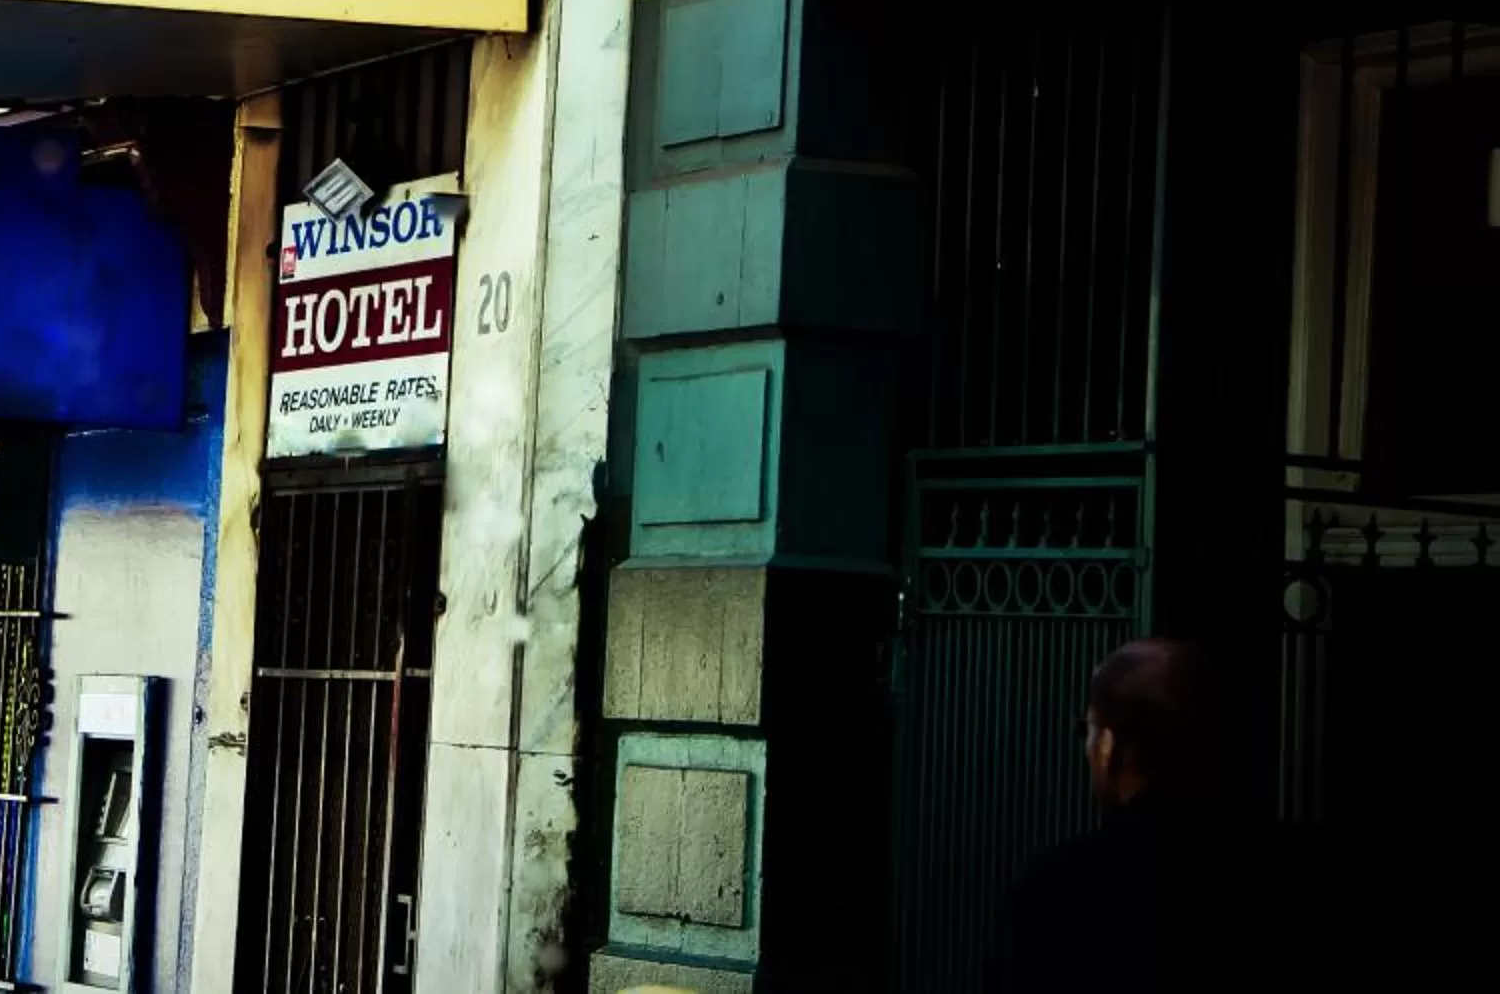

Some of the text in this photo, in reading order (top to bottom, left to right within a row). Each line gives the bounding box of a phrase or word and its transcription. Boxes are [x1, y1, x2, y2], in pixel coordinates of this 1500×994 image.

[291, 197, 444, 260] WINSOR
[281, 275, 443, 357] HOTEL
[476, 269, 512, 336] 20
[280, 376, 438, 414] REASONABLE RATES
[309, 408, 401, 434] DAILY WEEKLY
